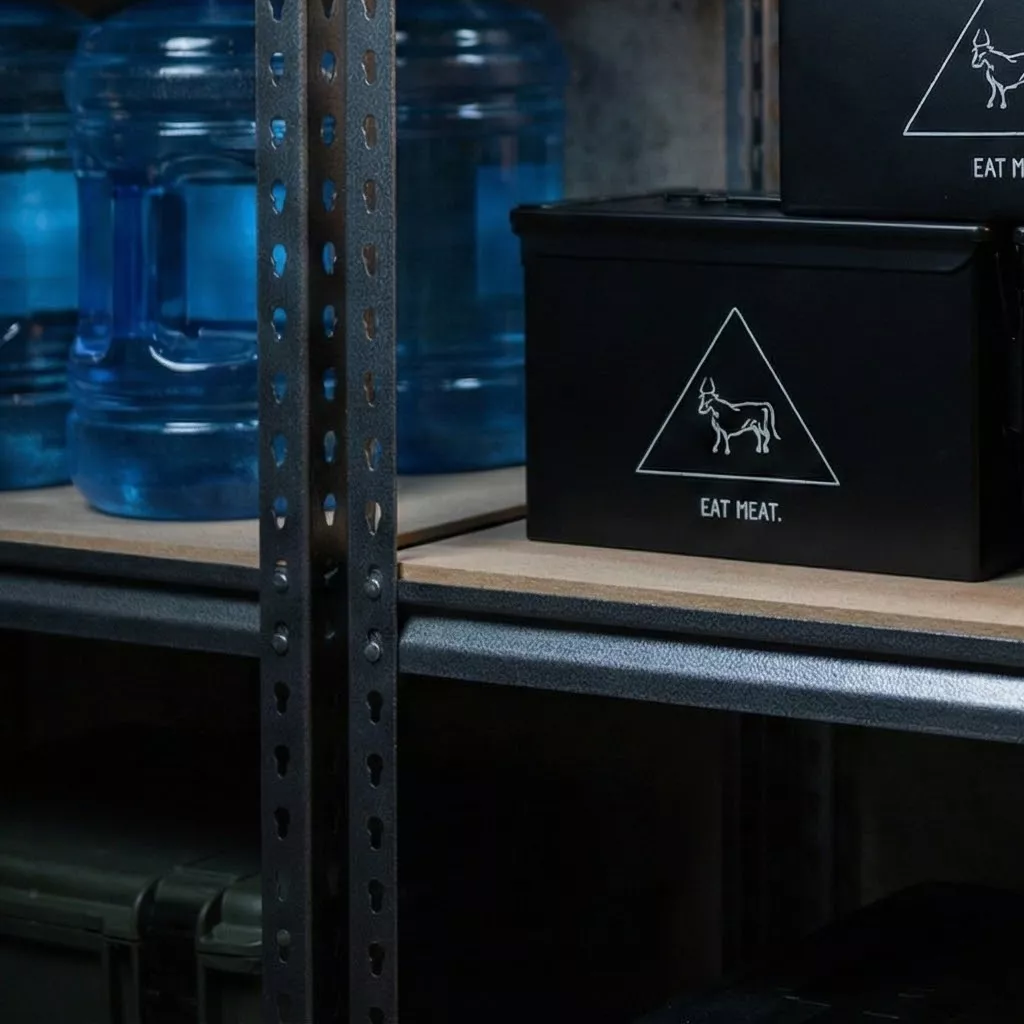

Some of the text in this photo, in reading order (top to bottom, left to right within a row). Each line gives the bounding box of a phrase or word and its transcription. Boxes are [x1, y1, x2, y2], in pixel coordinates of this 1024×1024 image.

[973, 157, 1007, 178] EAT
[700, 497, 782, 523] EAT MEAT.
